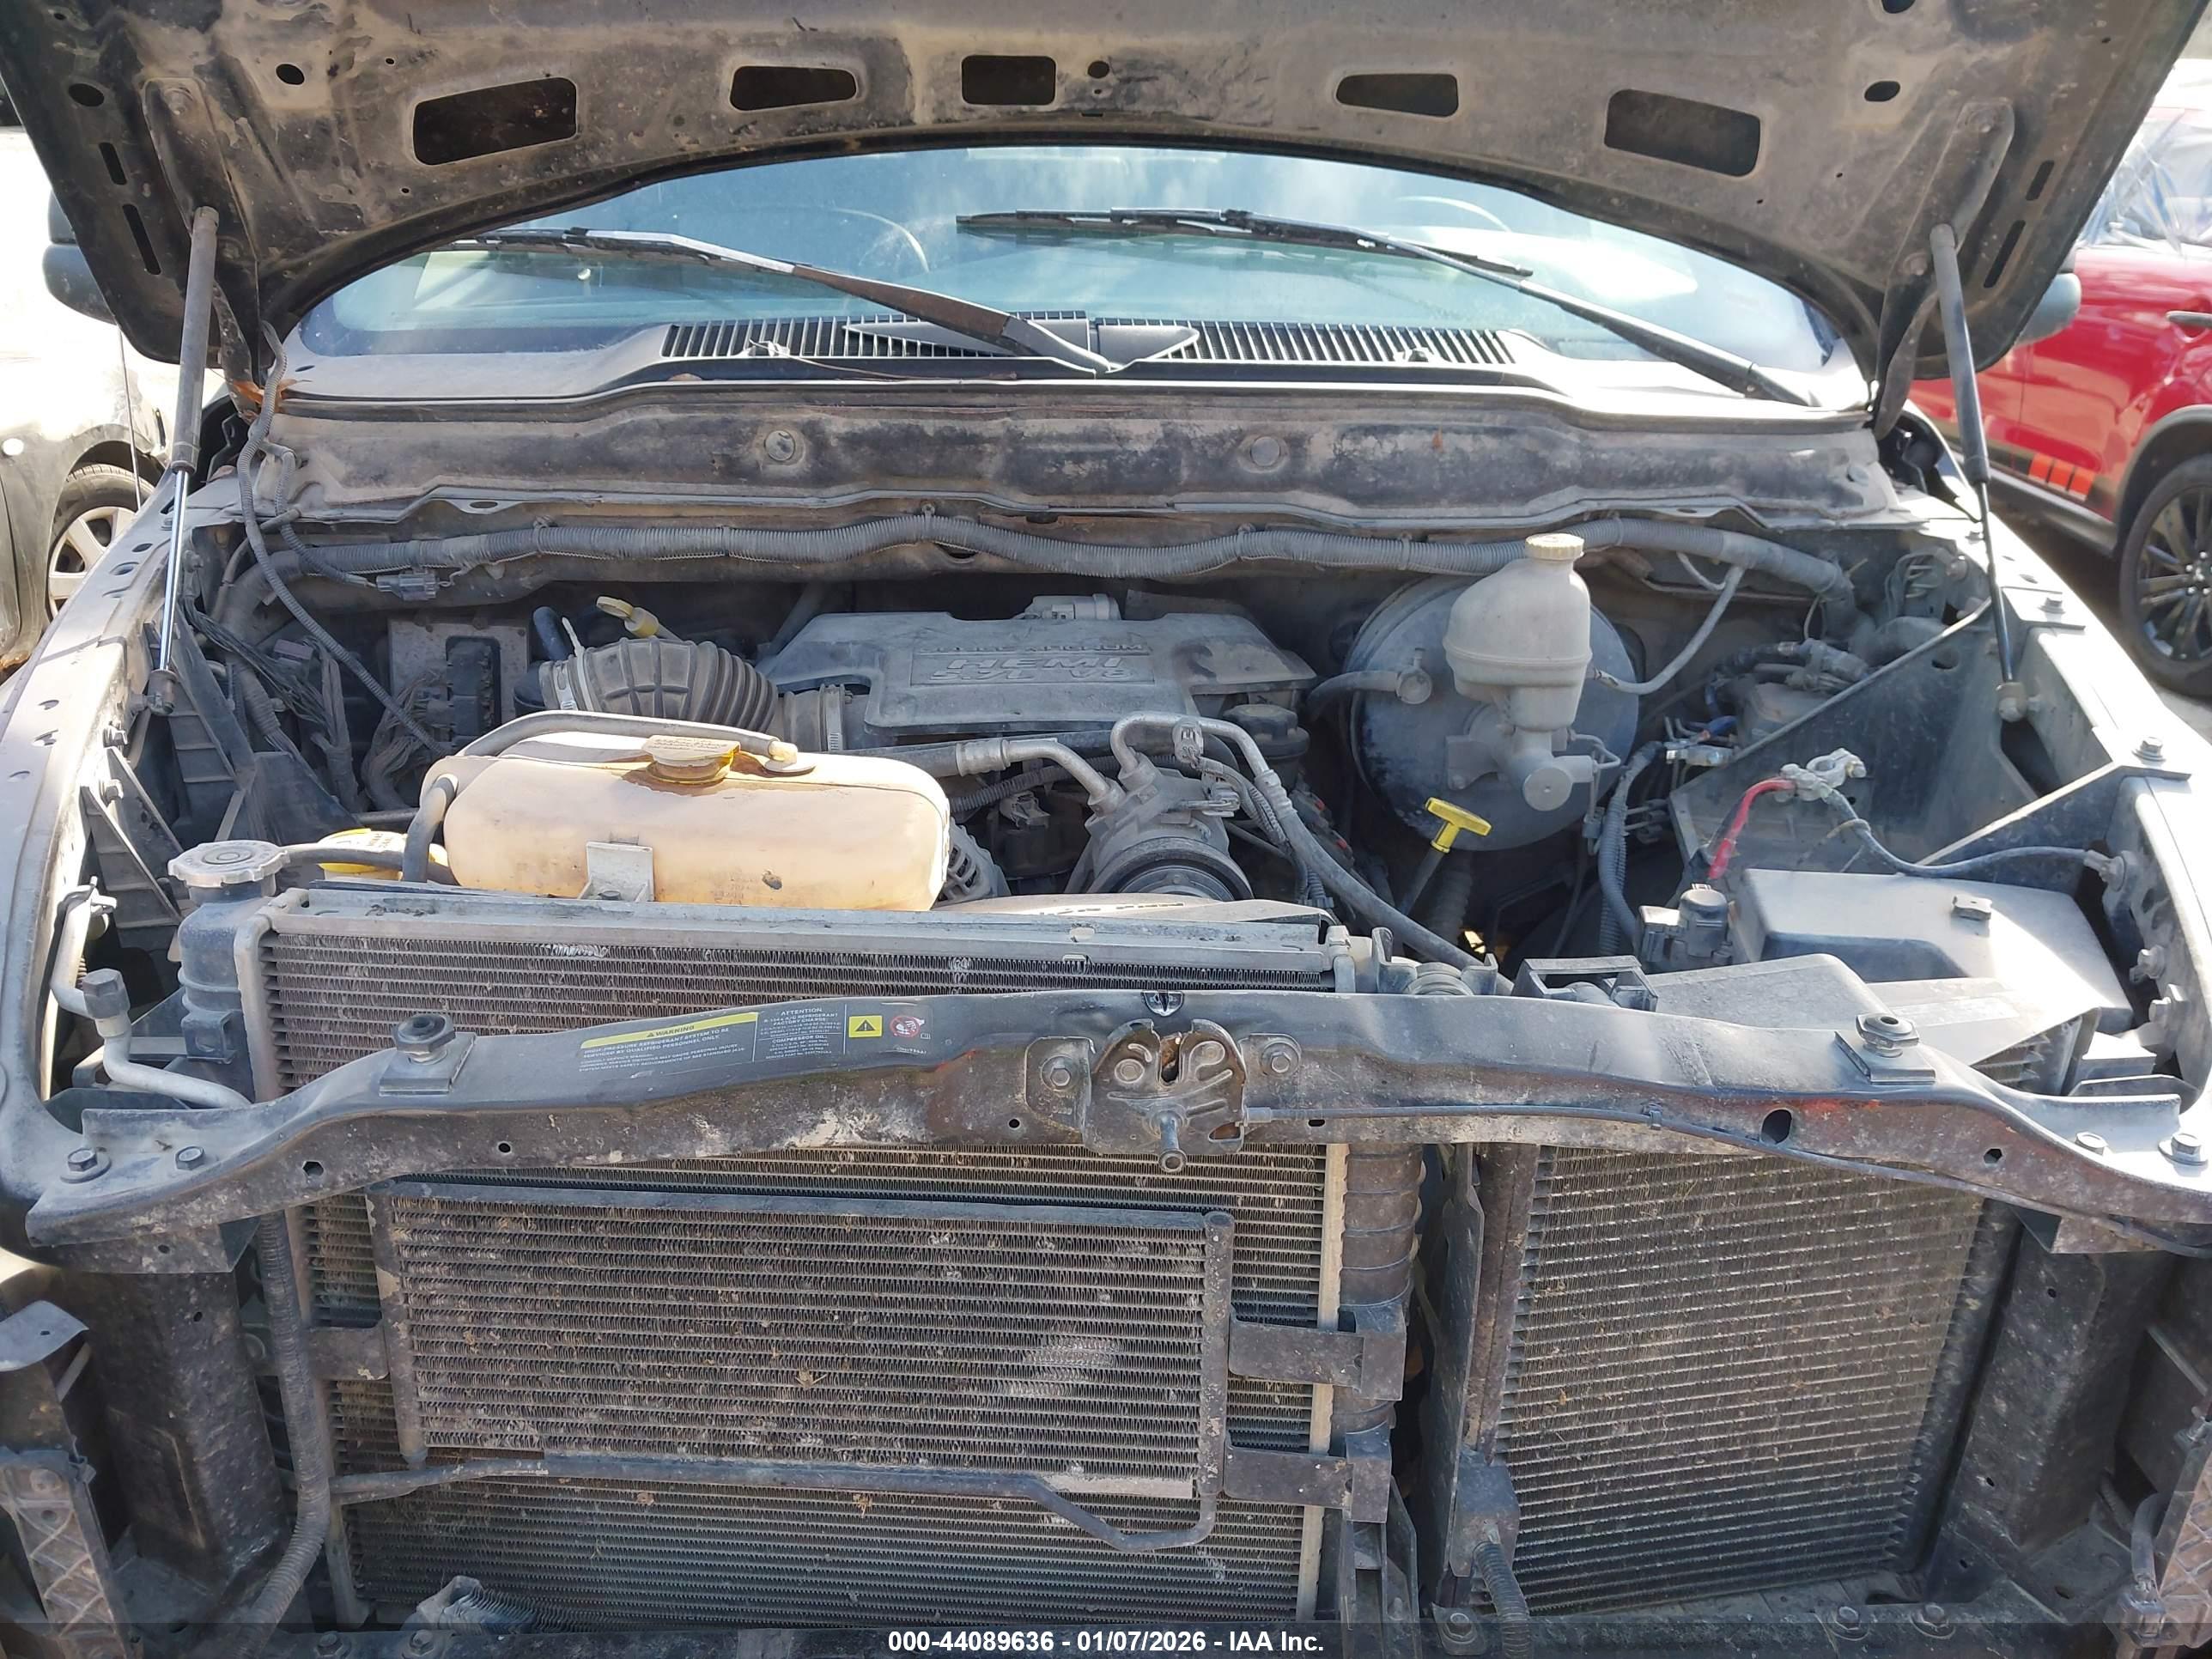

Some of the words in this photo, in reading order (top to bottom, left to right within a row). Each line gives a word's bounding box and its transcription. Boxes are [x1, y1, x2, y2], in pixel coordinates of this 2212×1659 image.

[946, 658, 1124, 669] HEMI
[929, 669, 1036, 681] 5.7L
[1068, 668, 1133, 680] V8
[780, 1007, 823, 1016] ATTENTION
[655, 1024, 695, 1036] WARNING
